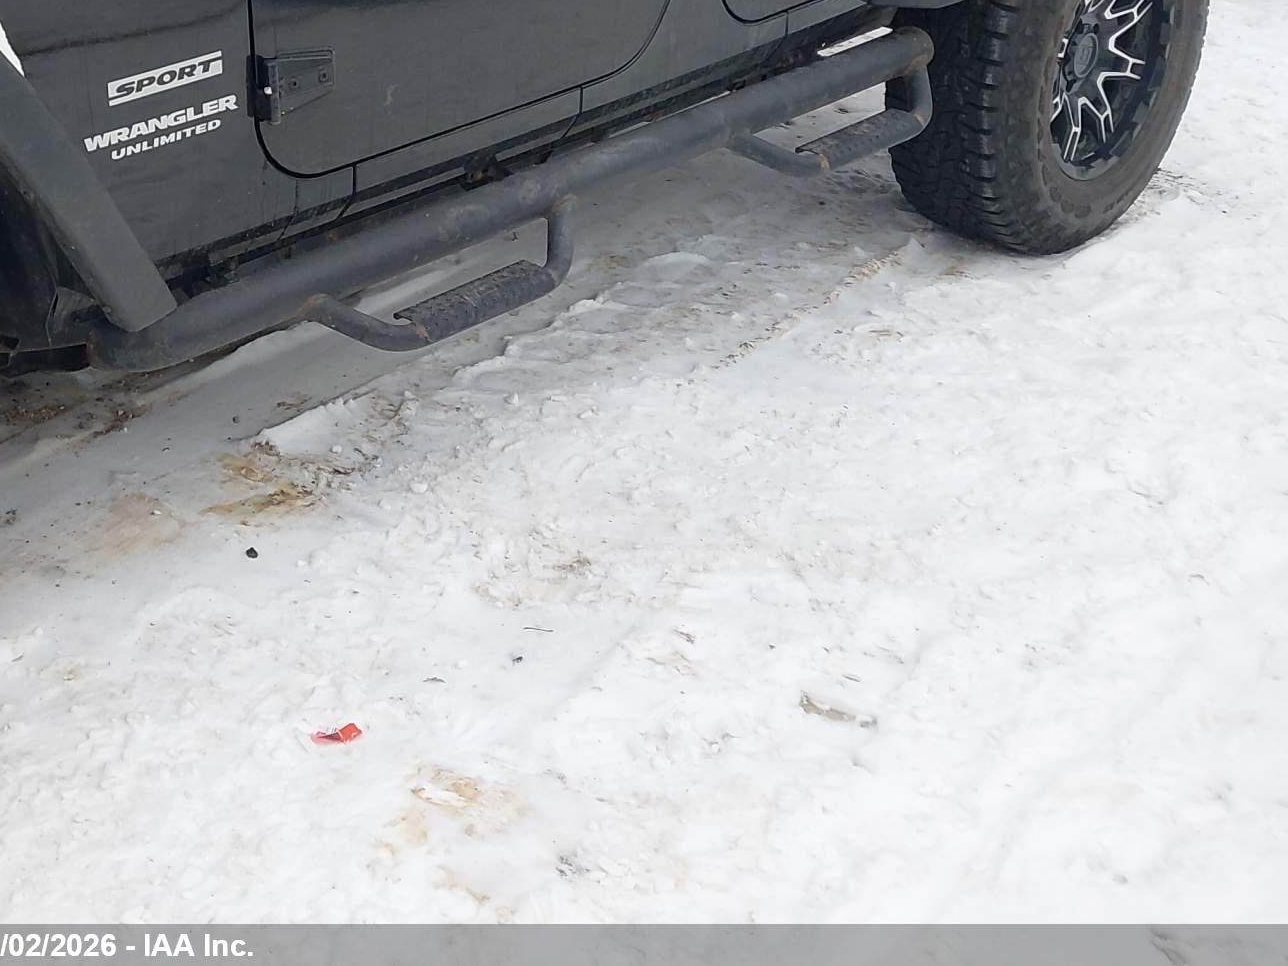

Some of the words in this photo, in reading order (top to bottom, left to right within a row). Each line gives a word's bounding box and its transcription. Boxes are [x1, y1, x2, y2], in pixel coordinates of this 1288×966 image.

[116, 58, 220, 97] SPORT
[84, 94, 238, 152] WRANGLER
[111, 119, 222, 161] UNLIMITED
